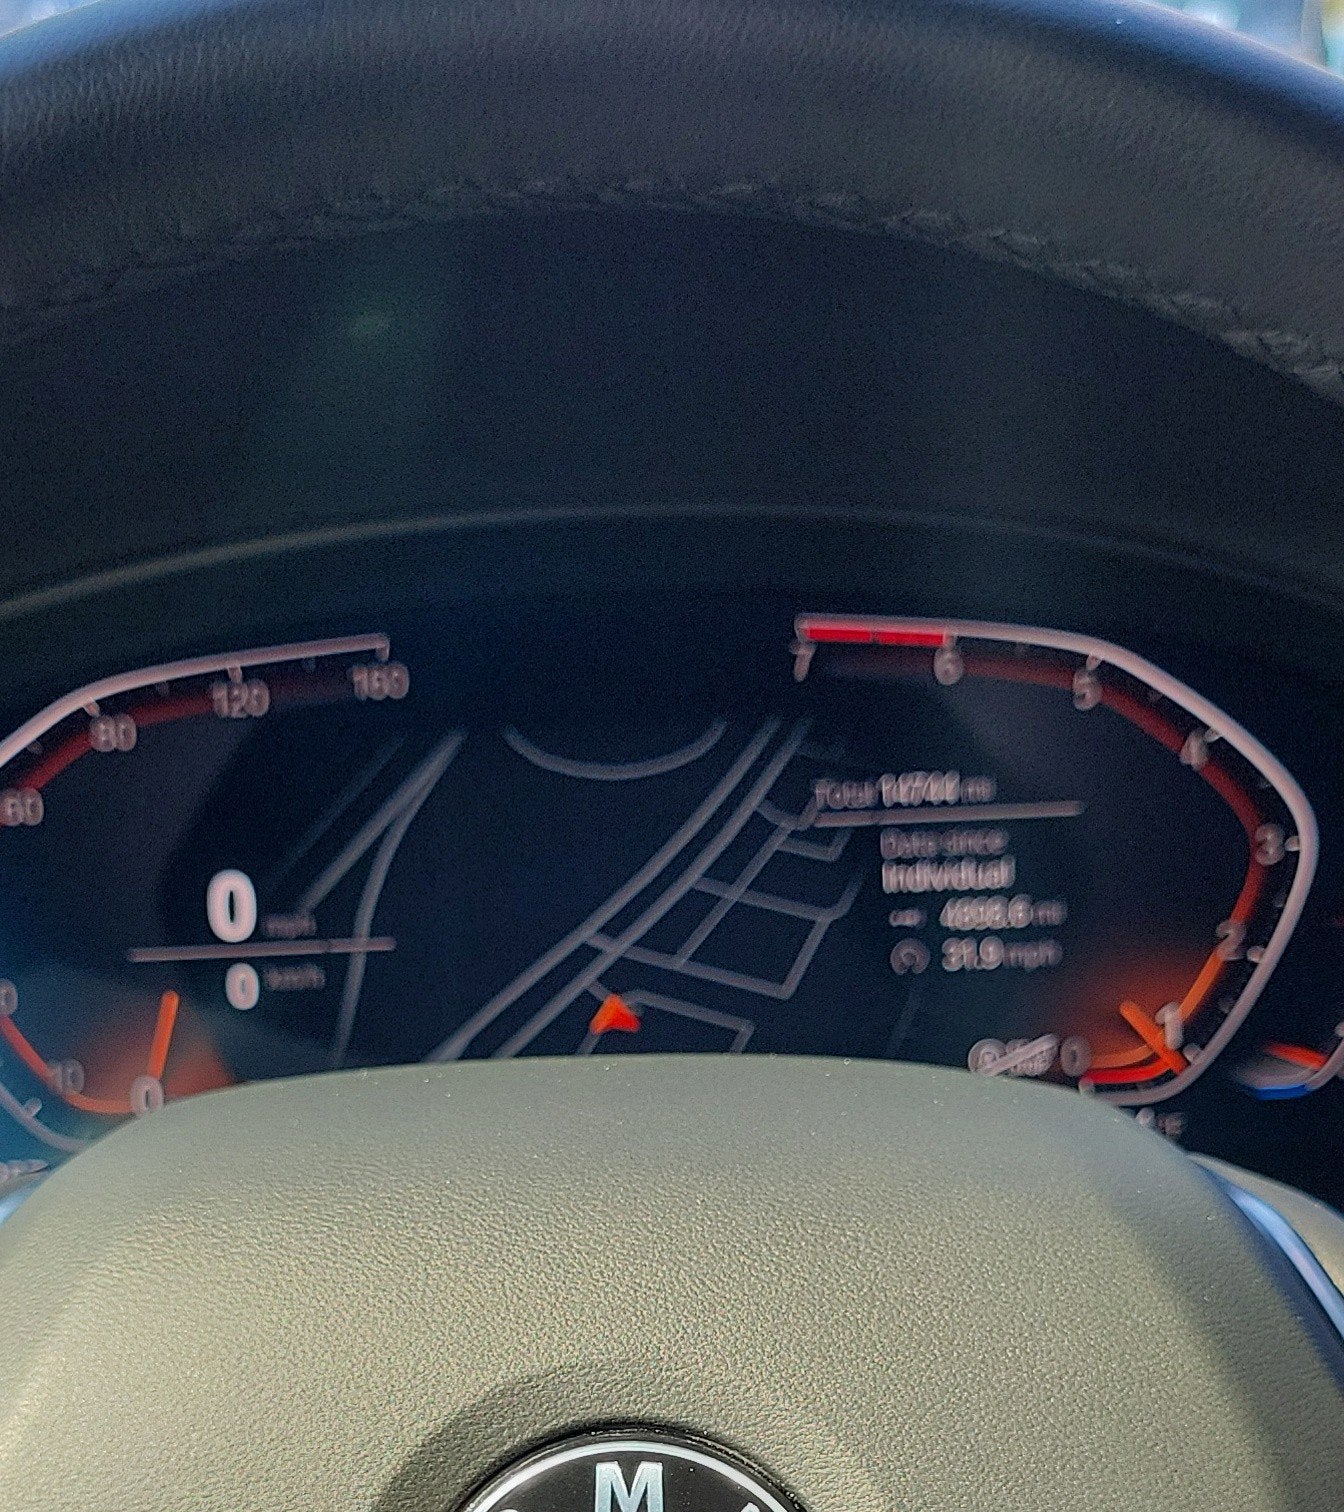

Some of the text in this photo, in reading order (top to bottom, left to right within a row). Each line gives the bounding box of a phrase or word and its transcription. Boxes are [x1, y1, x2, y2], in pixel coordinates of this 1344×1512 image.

[212, 680, 271, 719] 120
[353, 662, 410, 700] 160
[1072, 671, 1101, 711] 5
[90, 714, 137, 752] 80
[1256, 822, 1285, 865] 3
[206, 869, 257, 943] 0
[1215, 919, 1246, 961] 2
[225, 962, 260, 1011] 0
[130, 1074, 164, 1116] 0
